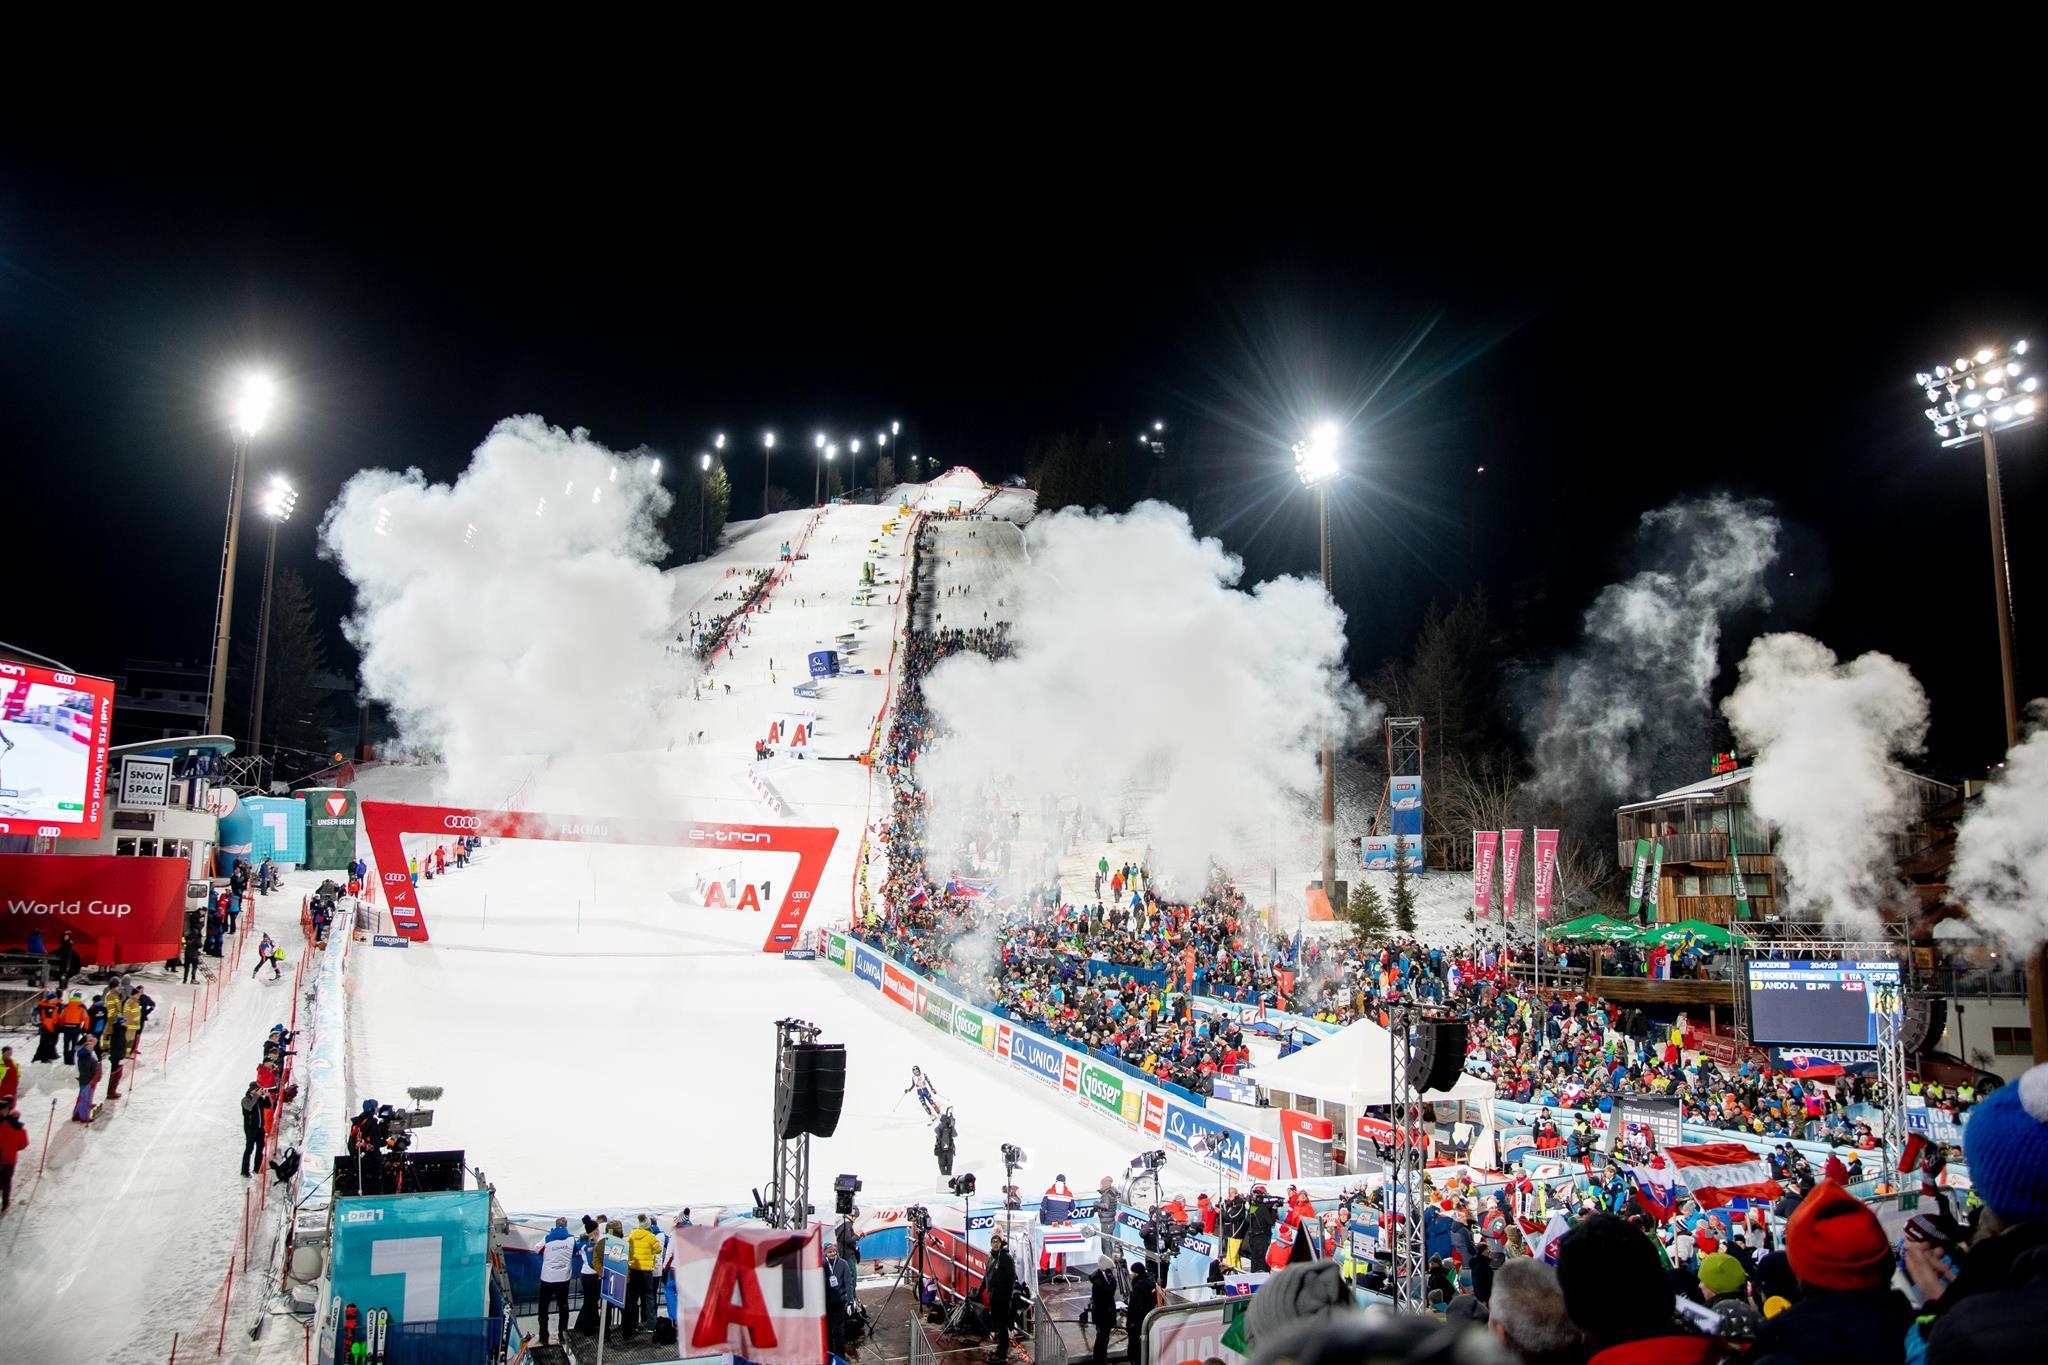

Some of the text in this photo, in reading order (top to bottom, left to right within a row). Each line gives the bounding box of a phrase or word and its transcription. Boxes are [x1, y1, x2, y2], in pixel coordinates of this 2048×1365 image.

[790, 721, 813, 747] A1
[89, 697, 110, 823] Audi FIS Ski World Cup
[130, 771, 164, 780] SNOW
[129, 784, 163, 794] SPACE
[318, 818, 338, 826] UNSER
[263, 812, 288, 851] 1
[688, 829, 772, 844] e-tron
[1630, 855, 1647, 899] Gösser
[1649, 859, 1662, 905] Gösser
[737, 881, 771, 912] A1
[7, 900, 132, 918] World Cup
[863, 961, 881, 982] UNIQA
[1764, 982, 1789, 991] ANDO
[1789, 982, 1798, 990] A.
[1841, 982, 1863, 991] +1.25
[956, 1007, 982, 1039] Gösser
[1028, 1046, 1062, 1077] UNIQA
[1082, 1064, 1121, 1106] Gösser
[1249, 1151, 1271, 1167] FLACHAU
[350, 1211, 373, 1222] ORF
[1067, 1207, 1094, 1219] ORT
[971, 1217, 995, 1229] SPO
[1127, 1216, 1147, 1230] SPO
[1184, 1237, 1210, 1255] SPORT
[692, 1235, 815, 1349] A1
